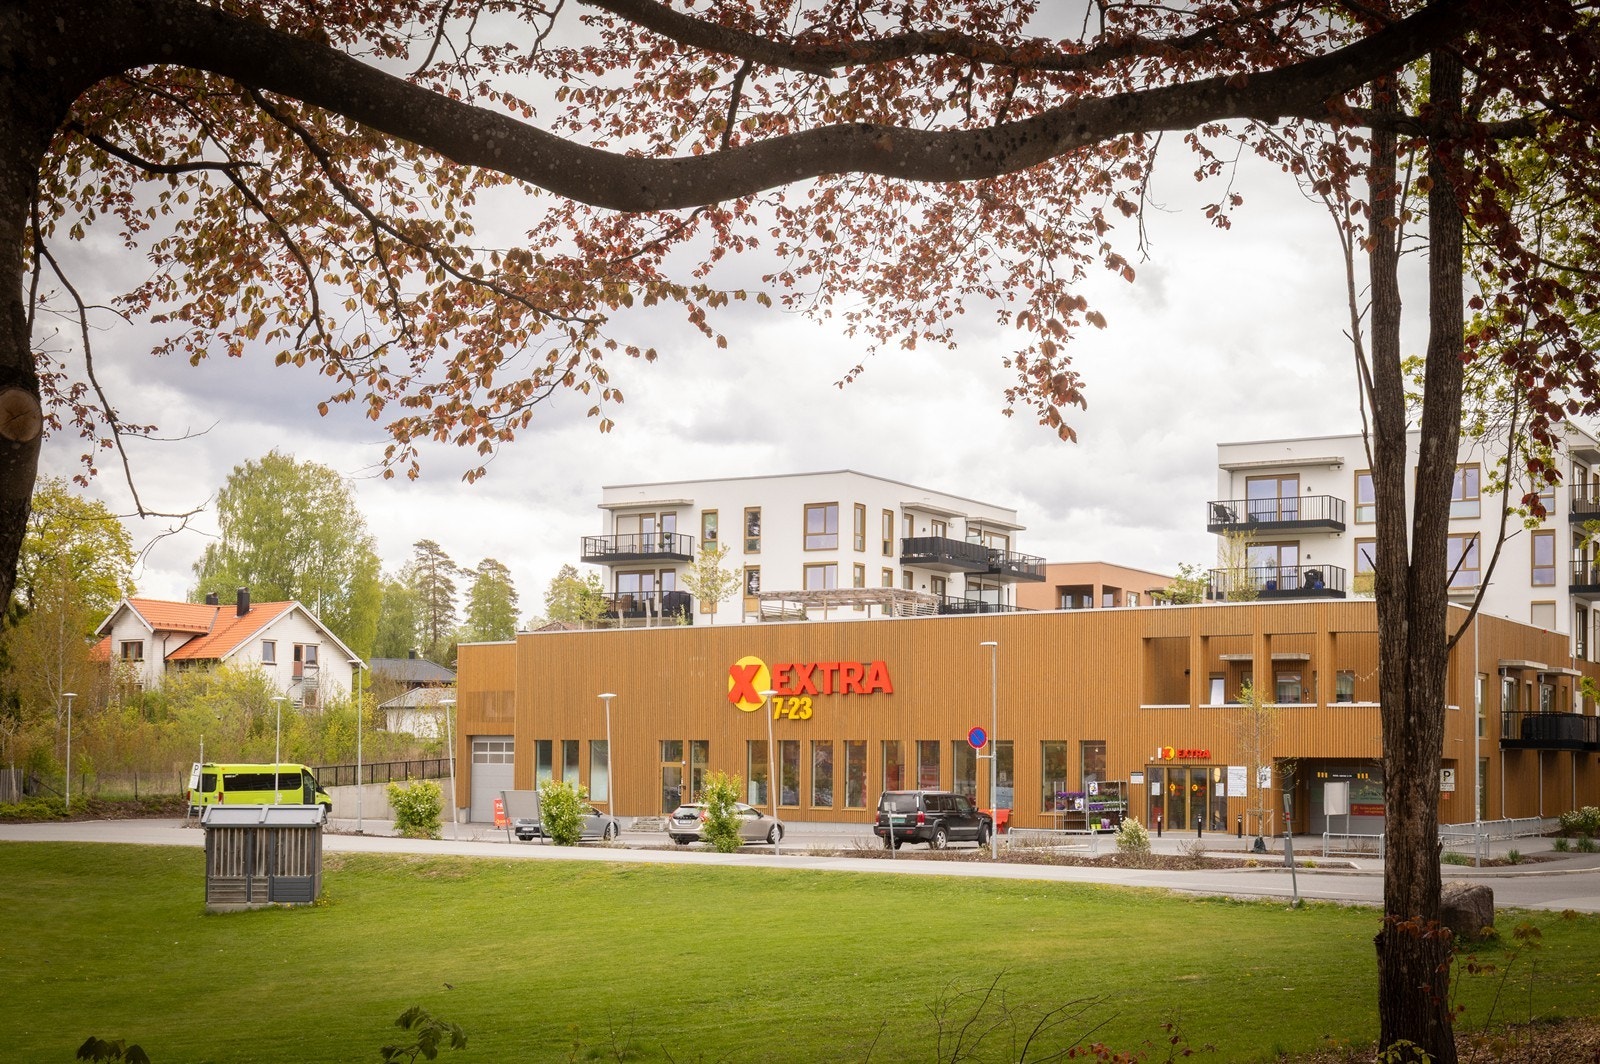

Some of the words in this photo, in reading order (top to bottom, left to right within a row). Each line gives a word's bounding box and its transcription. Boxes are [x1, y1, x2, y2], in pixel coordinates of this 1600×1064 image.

[772, 660, 894, 696] EXTRA
[772, 696, 813, 720] 7-23
[1177, 748, 1212, 759] EXTRA
[194, 764, 199, 774] P
[1443, 770, 1451, 782] P
